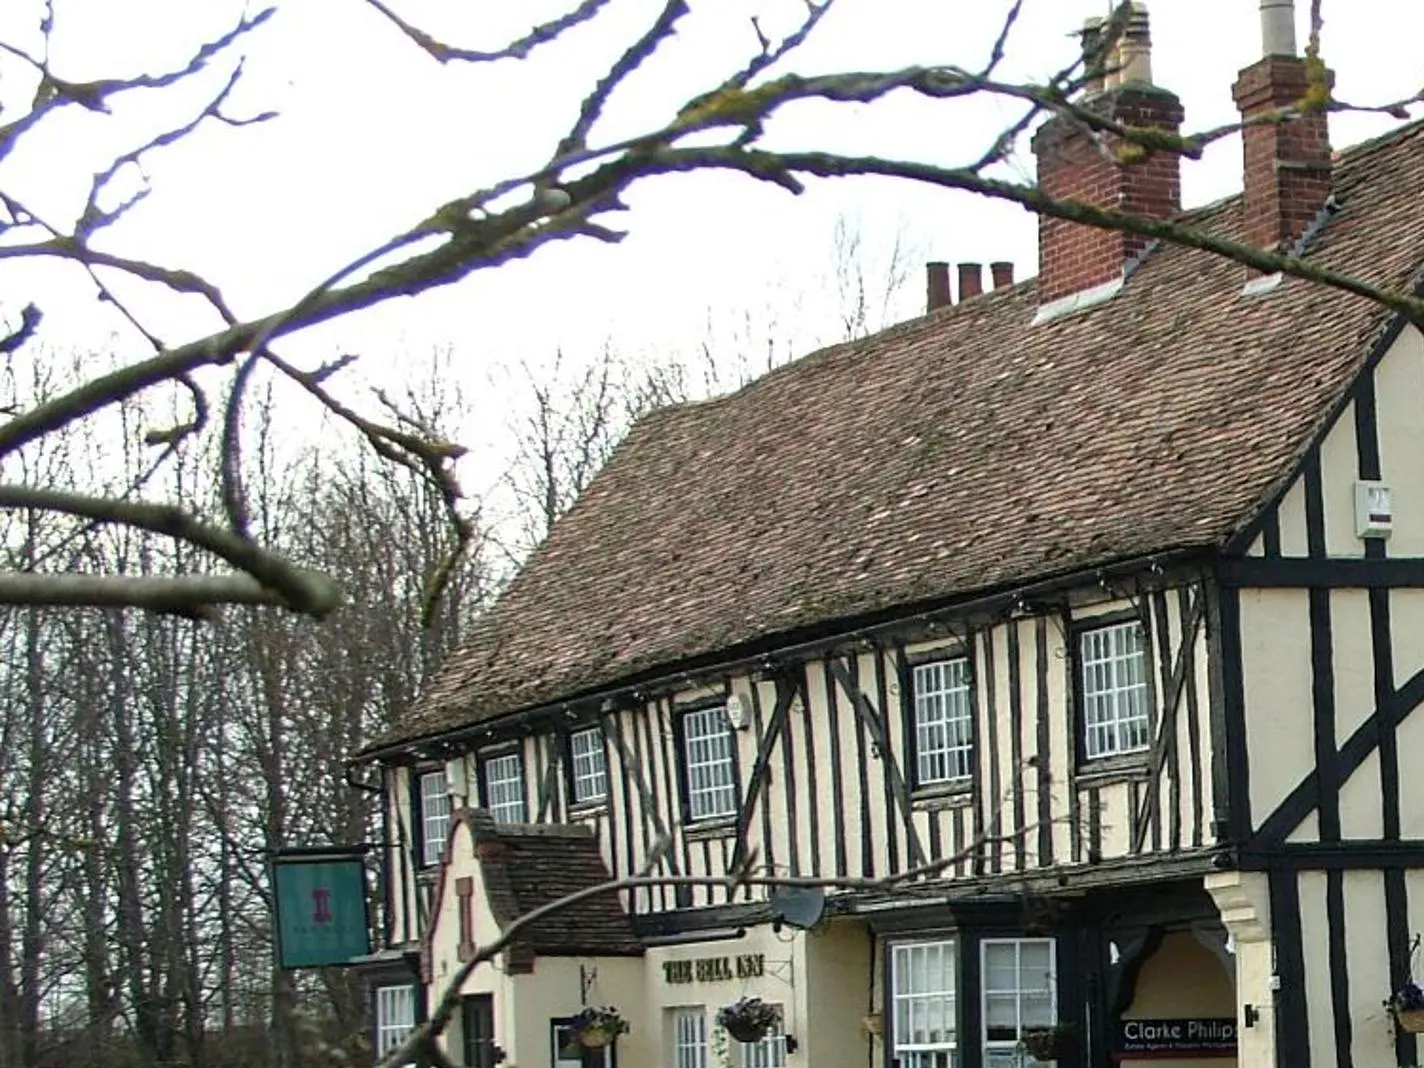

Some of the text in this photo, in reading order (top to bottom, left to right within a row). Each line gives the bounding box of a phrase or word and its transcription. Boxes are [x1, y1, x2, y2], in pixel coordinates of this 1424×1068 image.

[663, 953, 764, 984] THE BELL INN
[1124, 1021, 1181, 1040] Clarke
